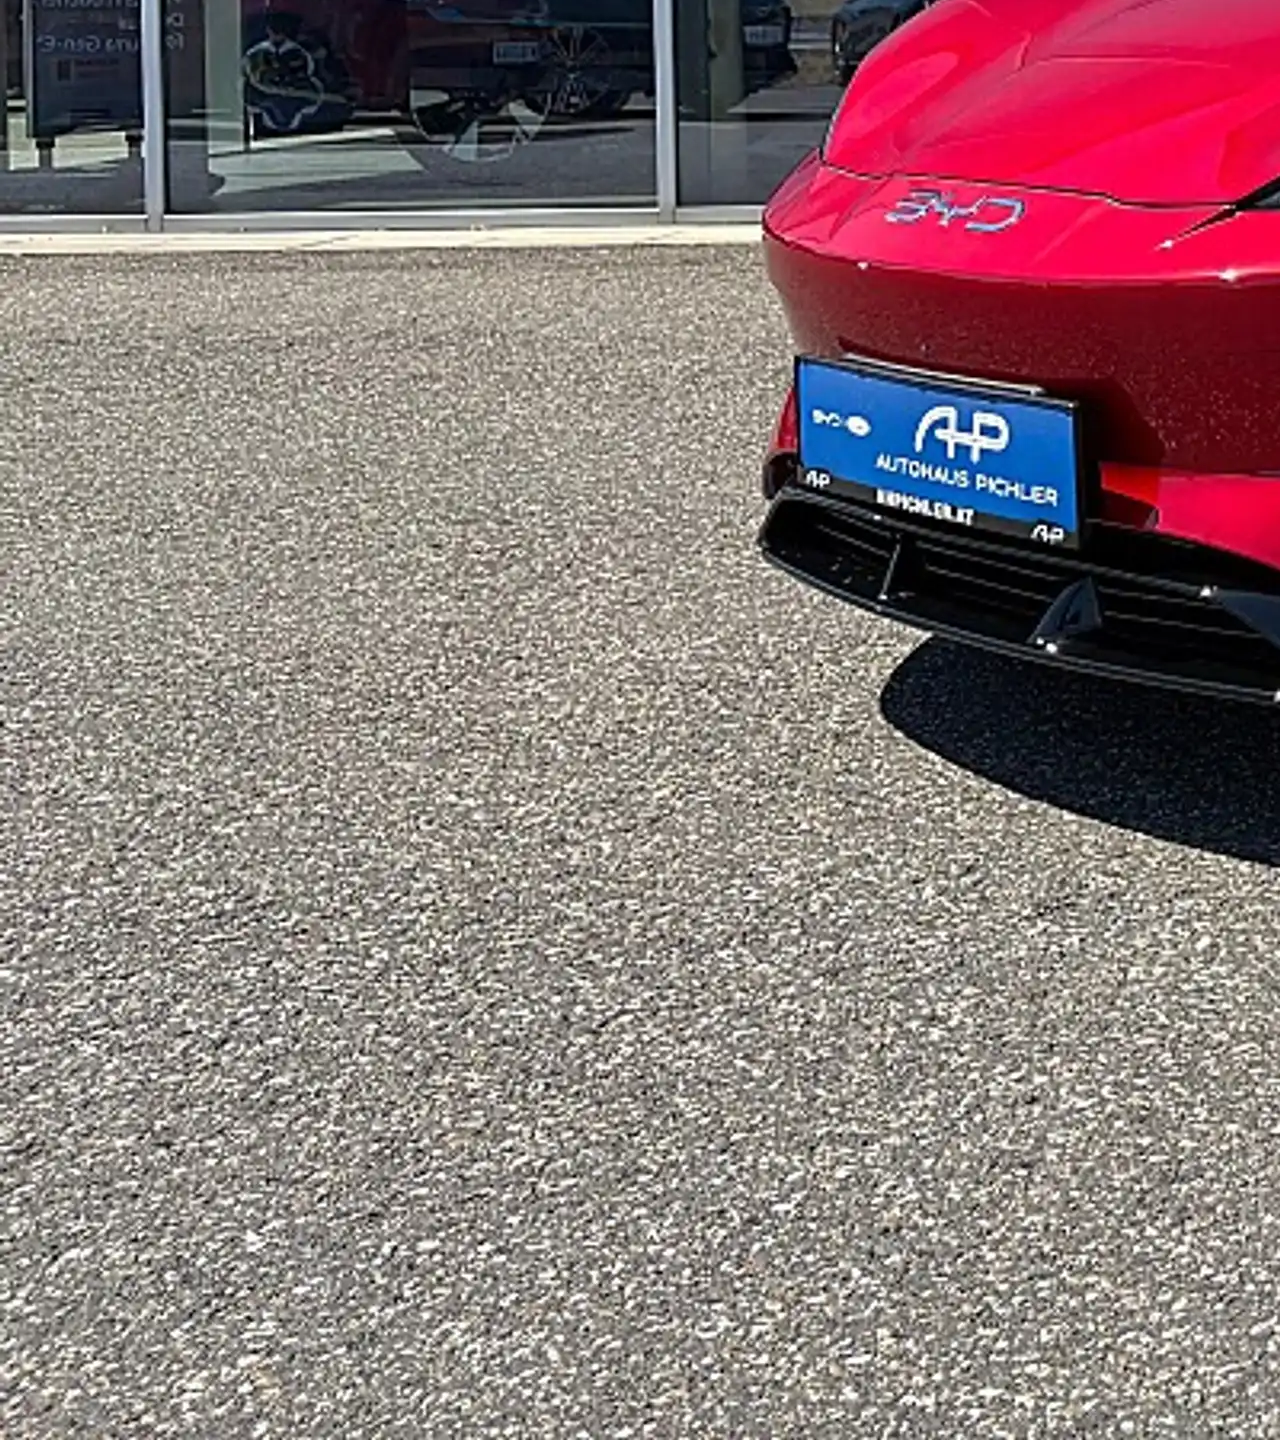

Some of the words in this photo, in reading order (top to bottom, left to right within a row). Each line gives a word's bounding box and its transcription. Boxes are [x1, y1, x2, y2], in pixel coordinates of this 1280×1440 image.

[884, 188, 1025, 233] BYD
[875, 452, 970, 488] AUTOHAUS
[975, 473, 1058, 508] PICHLER
